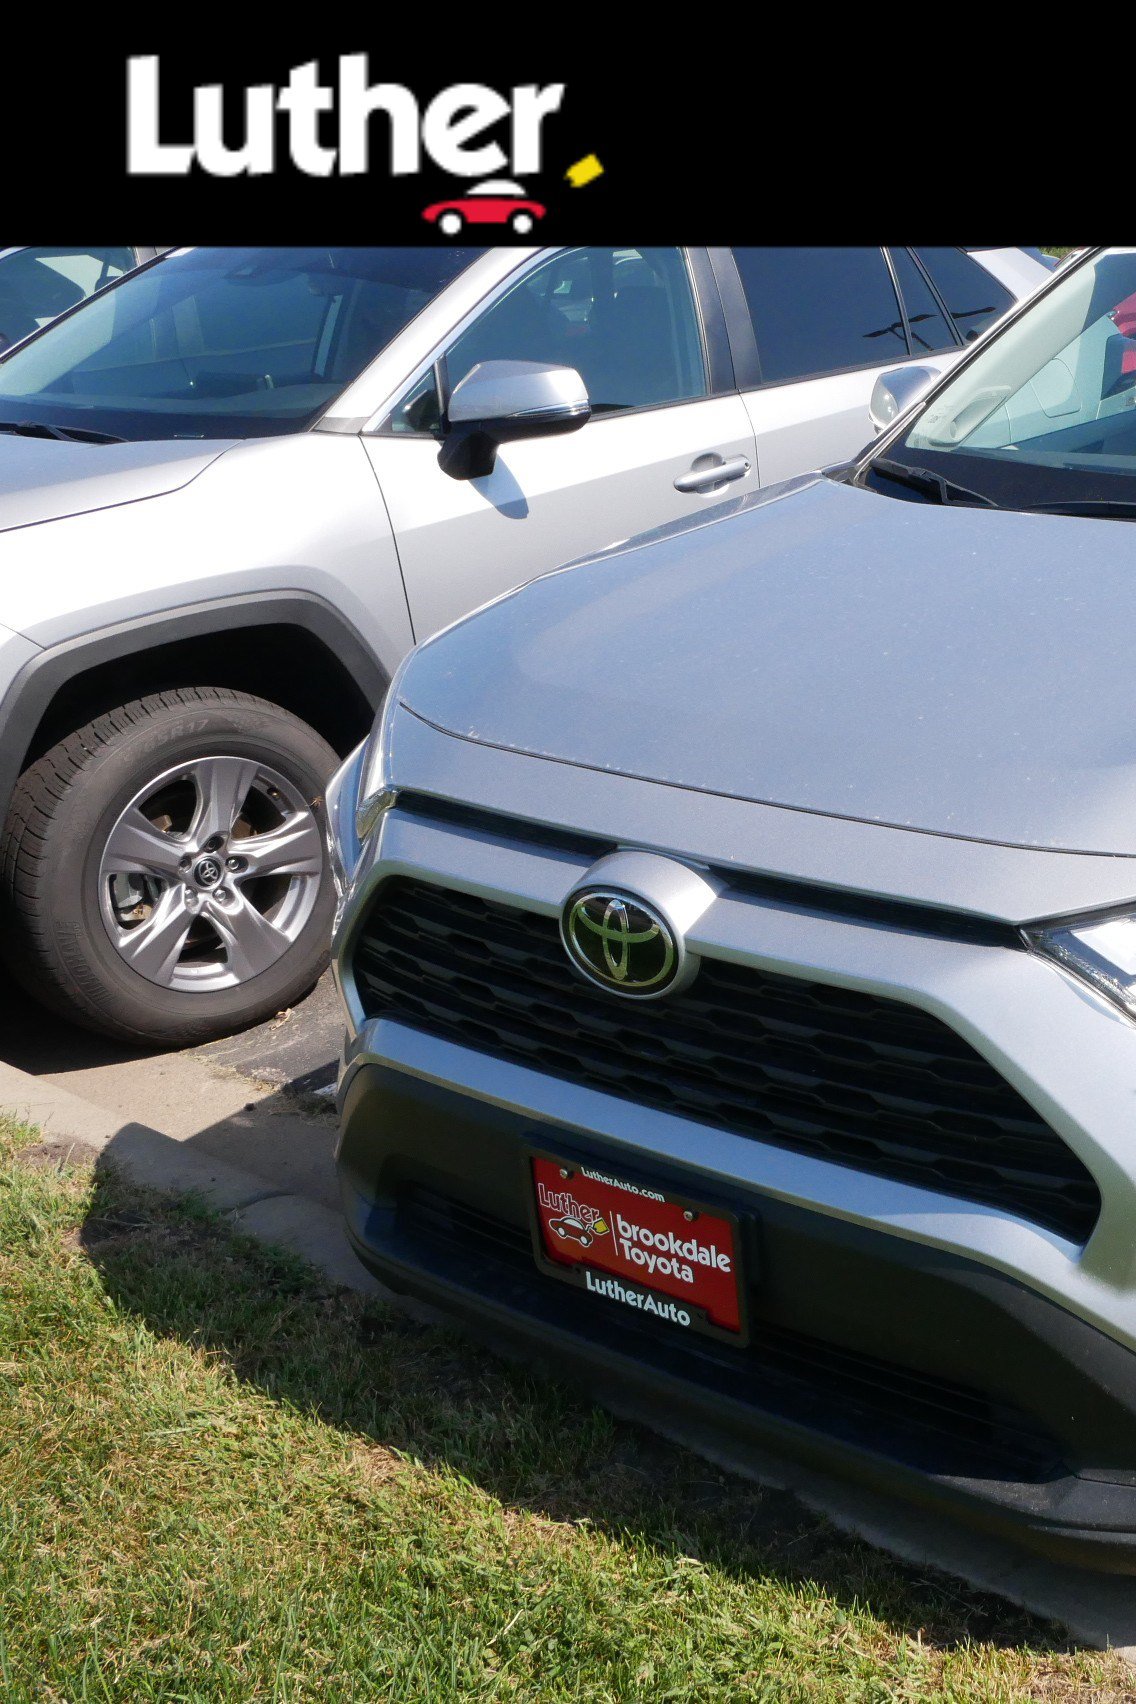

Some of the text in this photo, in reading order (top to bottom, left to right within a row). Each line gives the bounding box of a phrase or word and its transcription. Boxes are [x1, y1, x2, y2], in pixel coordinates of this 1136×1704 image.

[538, 1183, 600, 1223] Luther
[581, 1167, 665, 1202] LutherAuto.com
[617, 1214, 731, 1273] brookdale
[620, 1239, 694, 1283] Toyota
[586, 1271, 691, 1326] LutherAuto
